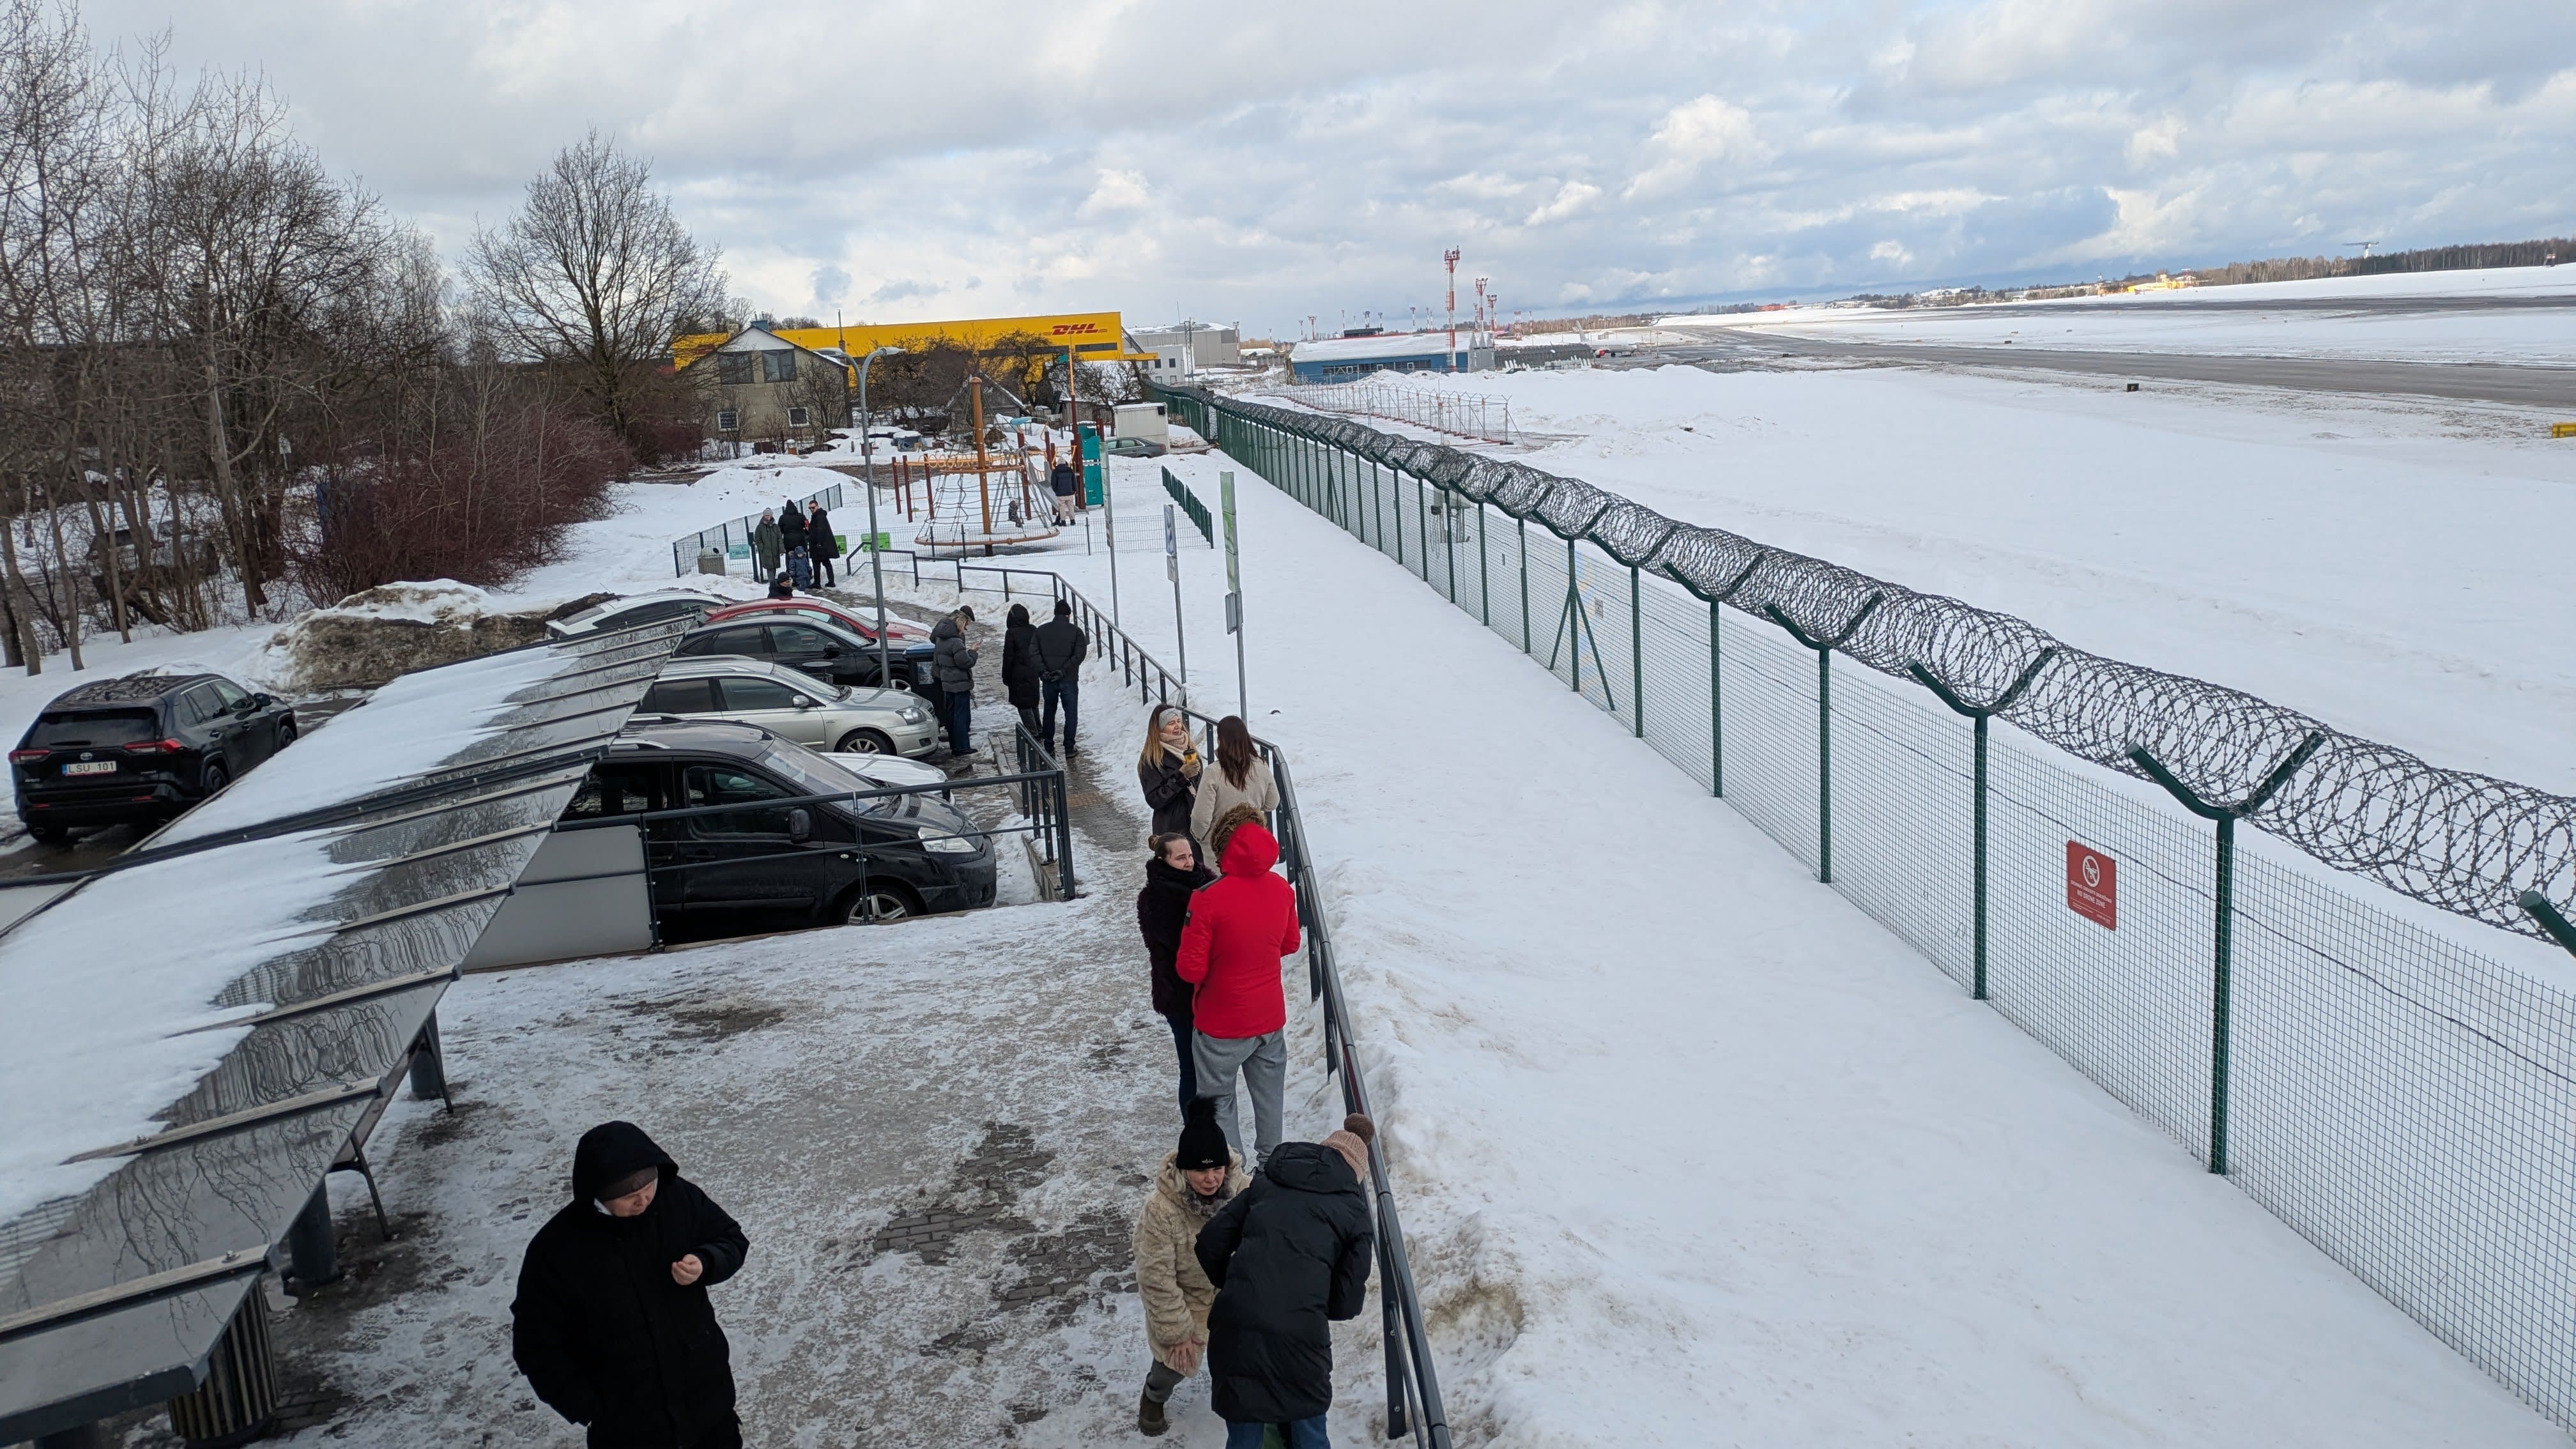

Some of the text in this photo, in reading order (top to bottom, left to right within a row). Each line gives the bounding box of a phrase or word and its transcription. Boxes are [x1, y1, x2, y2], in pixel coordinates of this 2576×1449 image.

[1052, 323, 1098, 335] DHL
[68, 763, 114, 773] LSU 101
[2083, 892, 2095, 904] DRONE
[2096, 898, 2106, 908] ZONE
